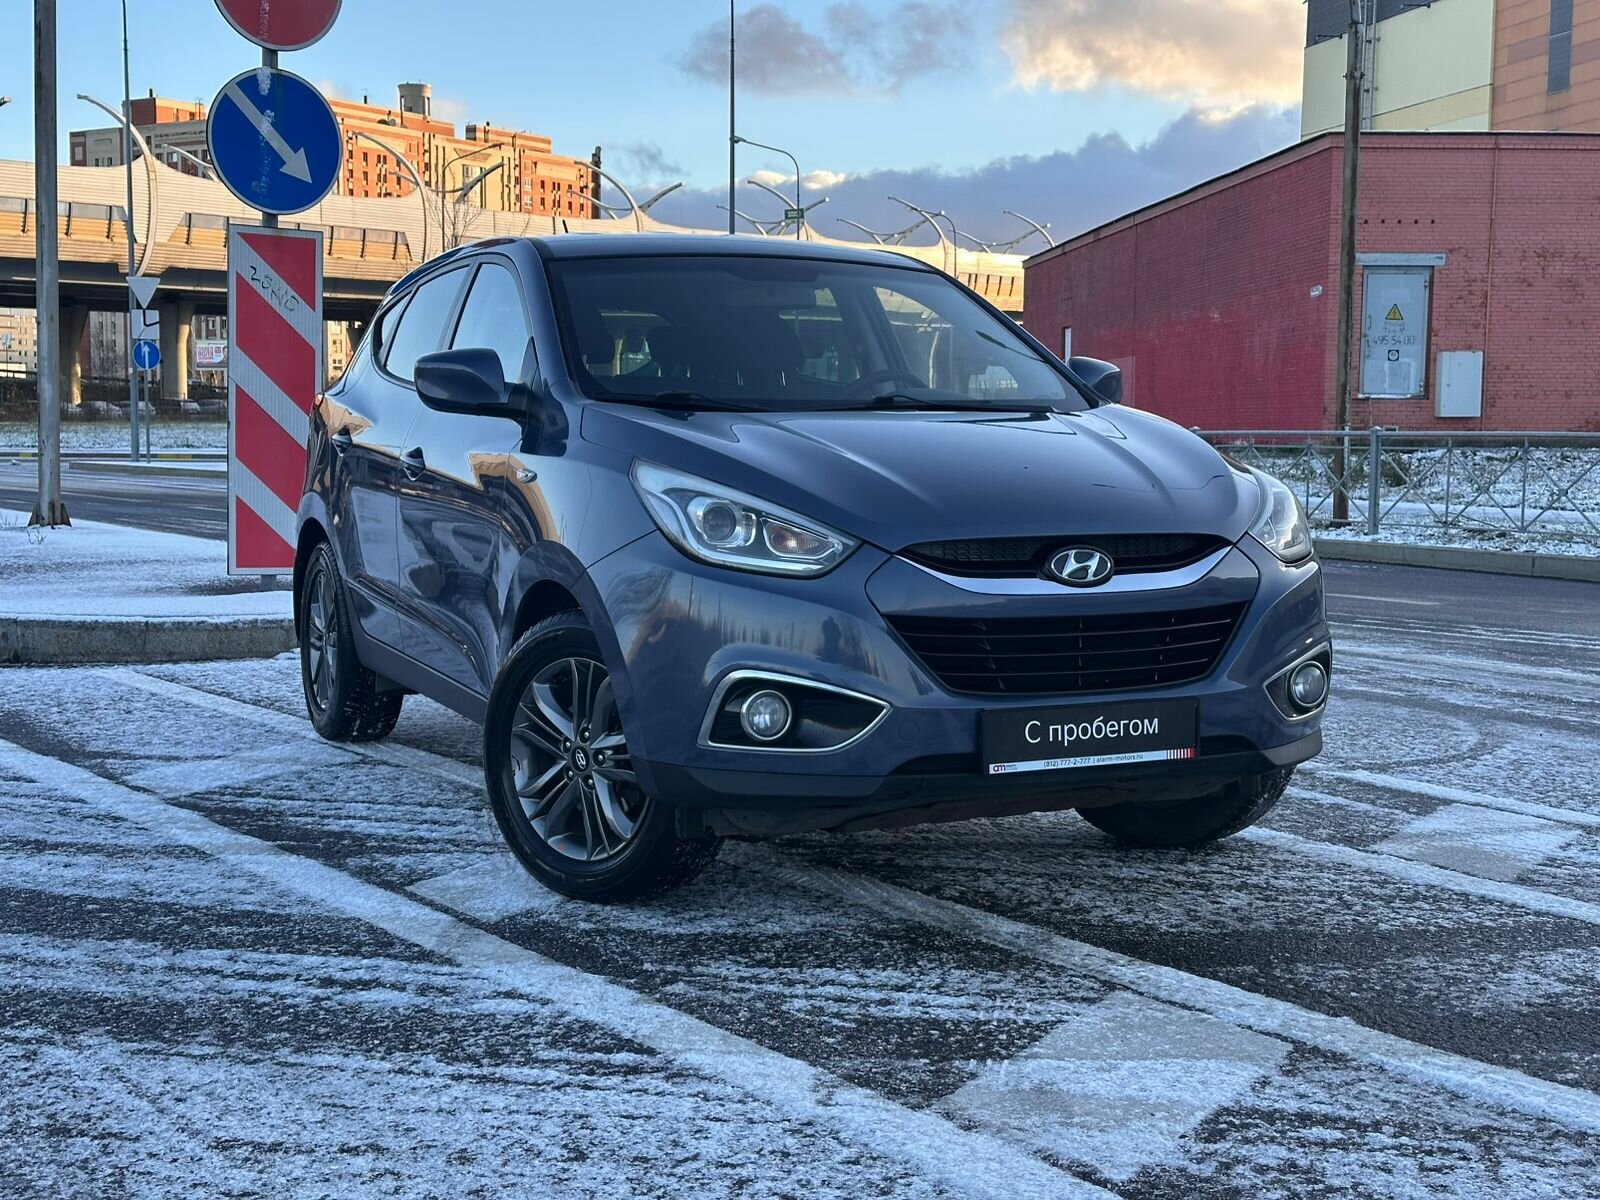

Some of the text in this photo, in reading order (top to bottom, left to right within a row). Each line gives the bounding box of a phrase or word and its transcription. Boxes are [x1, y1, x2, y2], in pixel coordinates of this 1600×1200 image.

[1025, 716, 1159, 747] С пробегом
[1043, 754, 1144, 768] (812) 777-2-777 alarm-motors.ru
